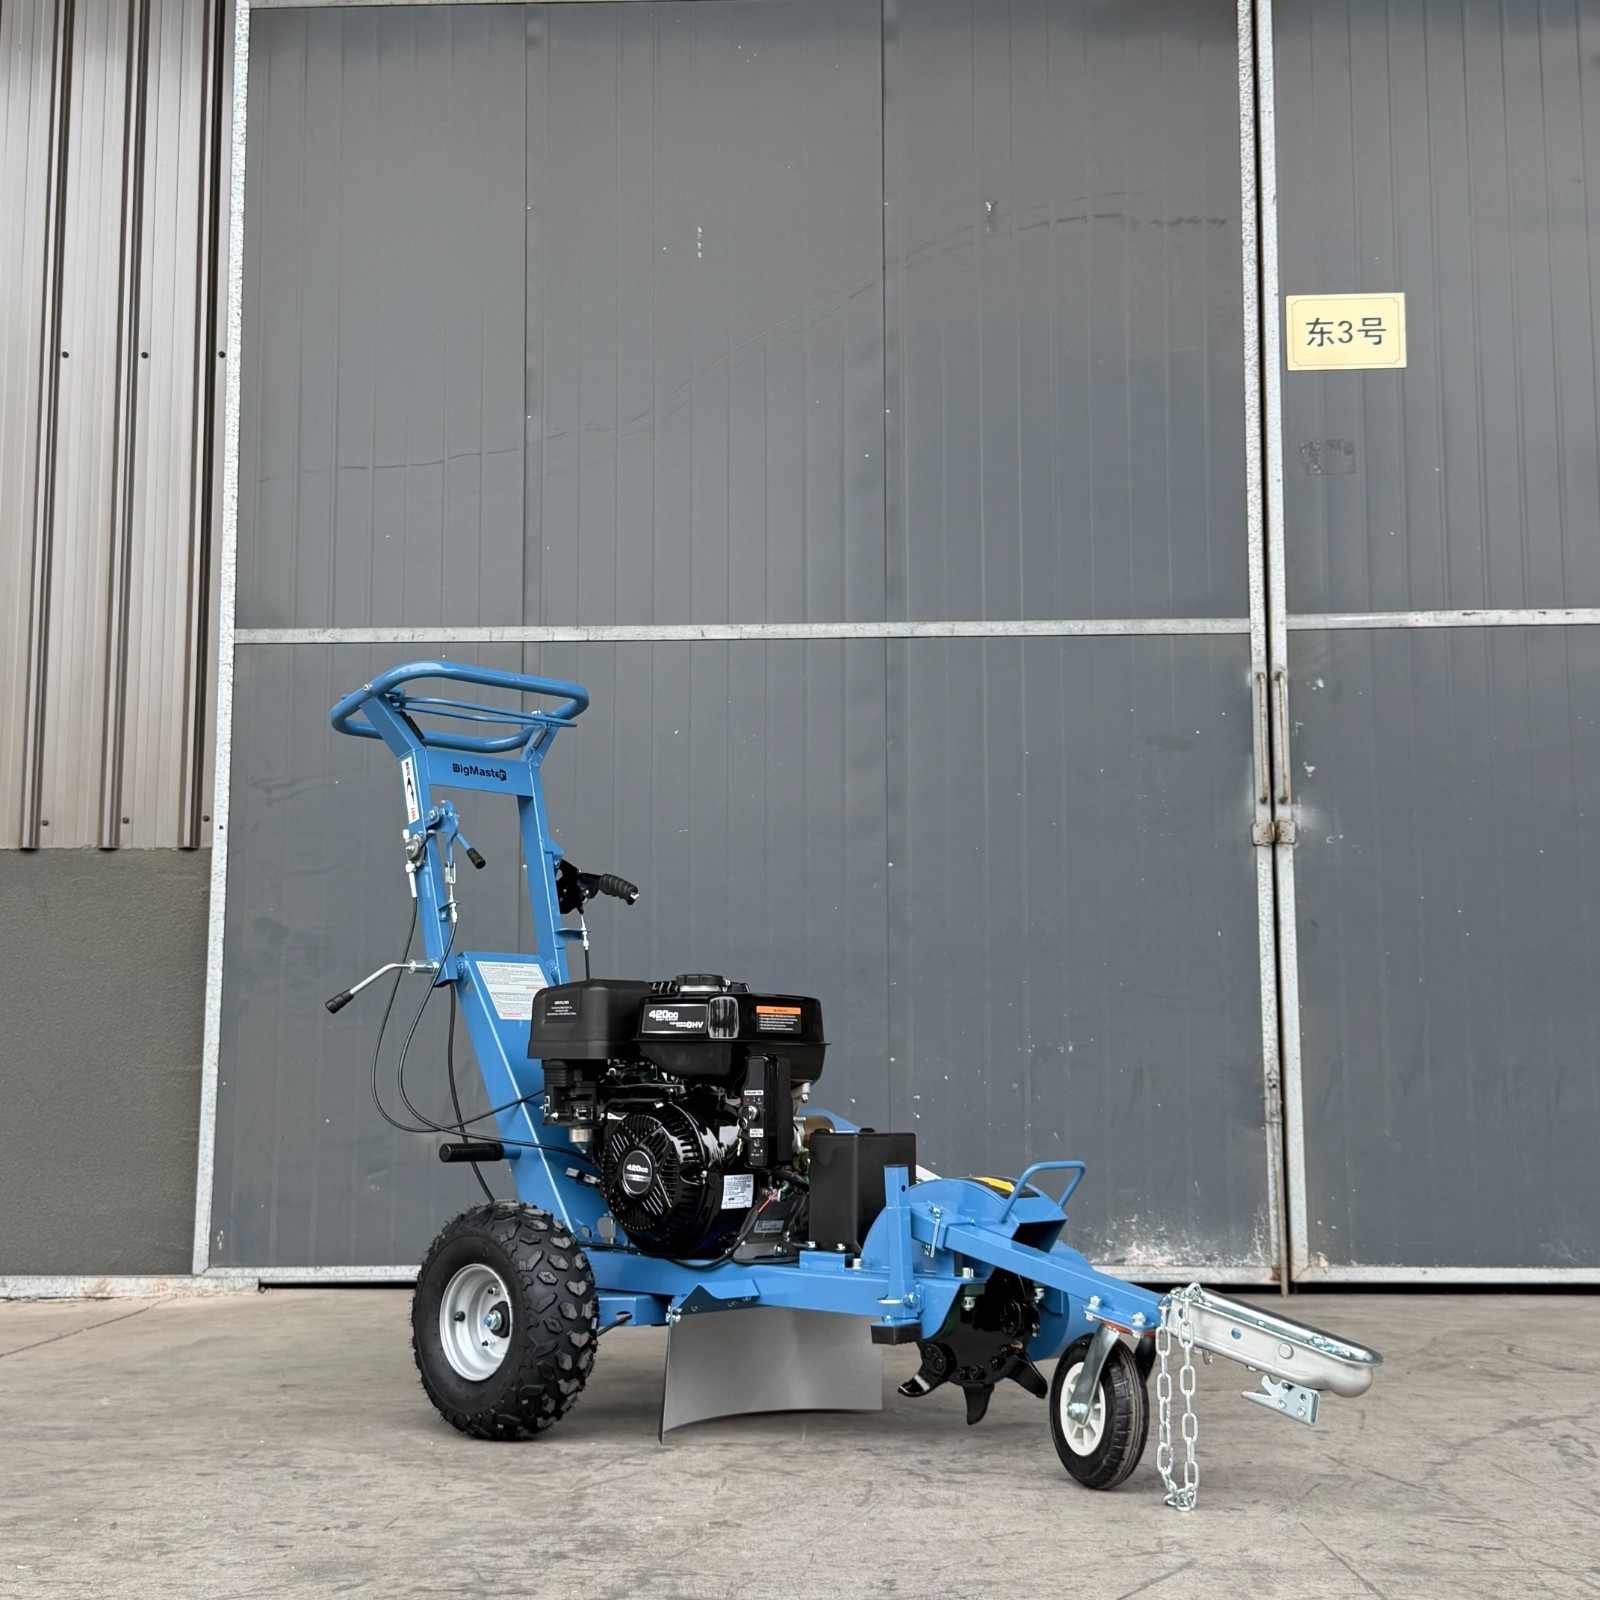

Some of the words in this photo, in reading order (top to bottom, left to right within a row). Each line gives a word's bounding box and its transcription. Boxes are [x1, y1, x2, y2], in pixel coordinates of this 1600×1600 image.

[1305, 317, 1387, 347] 东3号
[648, 1009, 679, 1018] 420cc
[686, 1020, 704, 1029] OHV
[626, 1164, 649, 1173] 420cc
